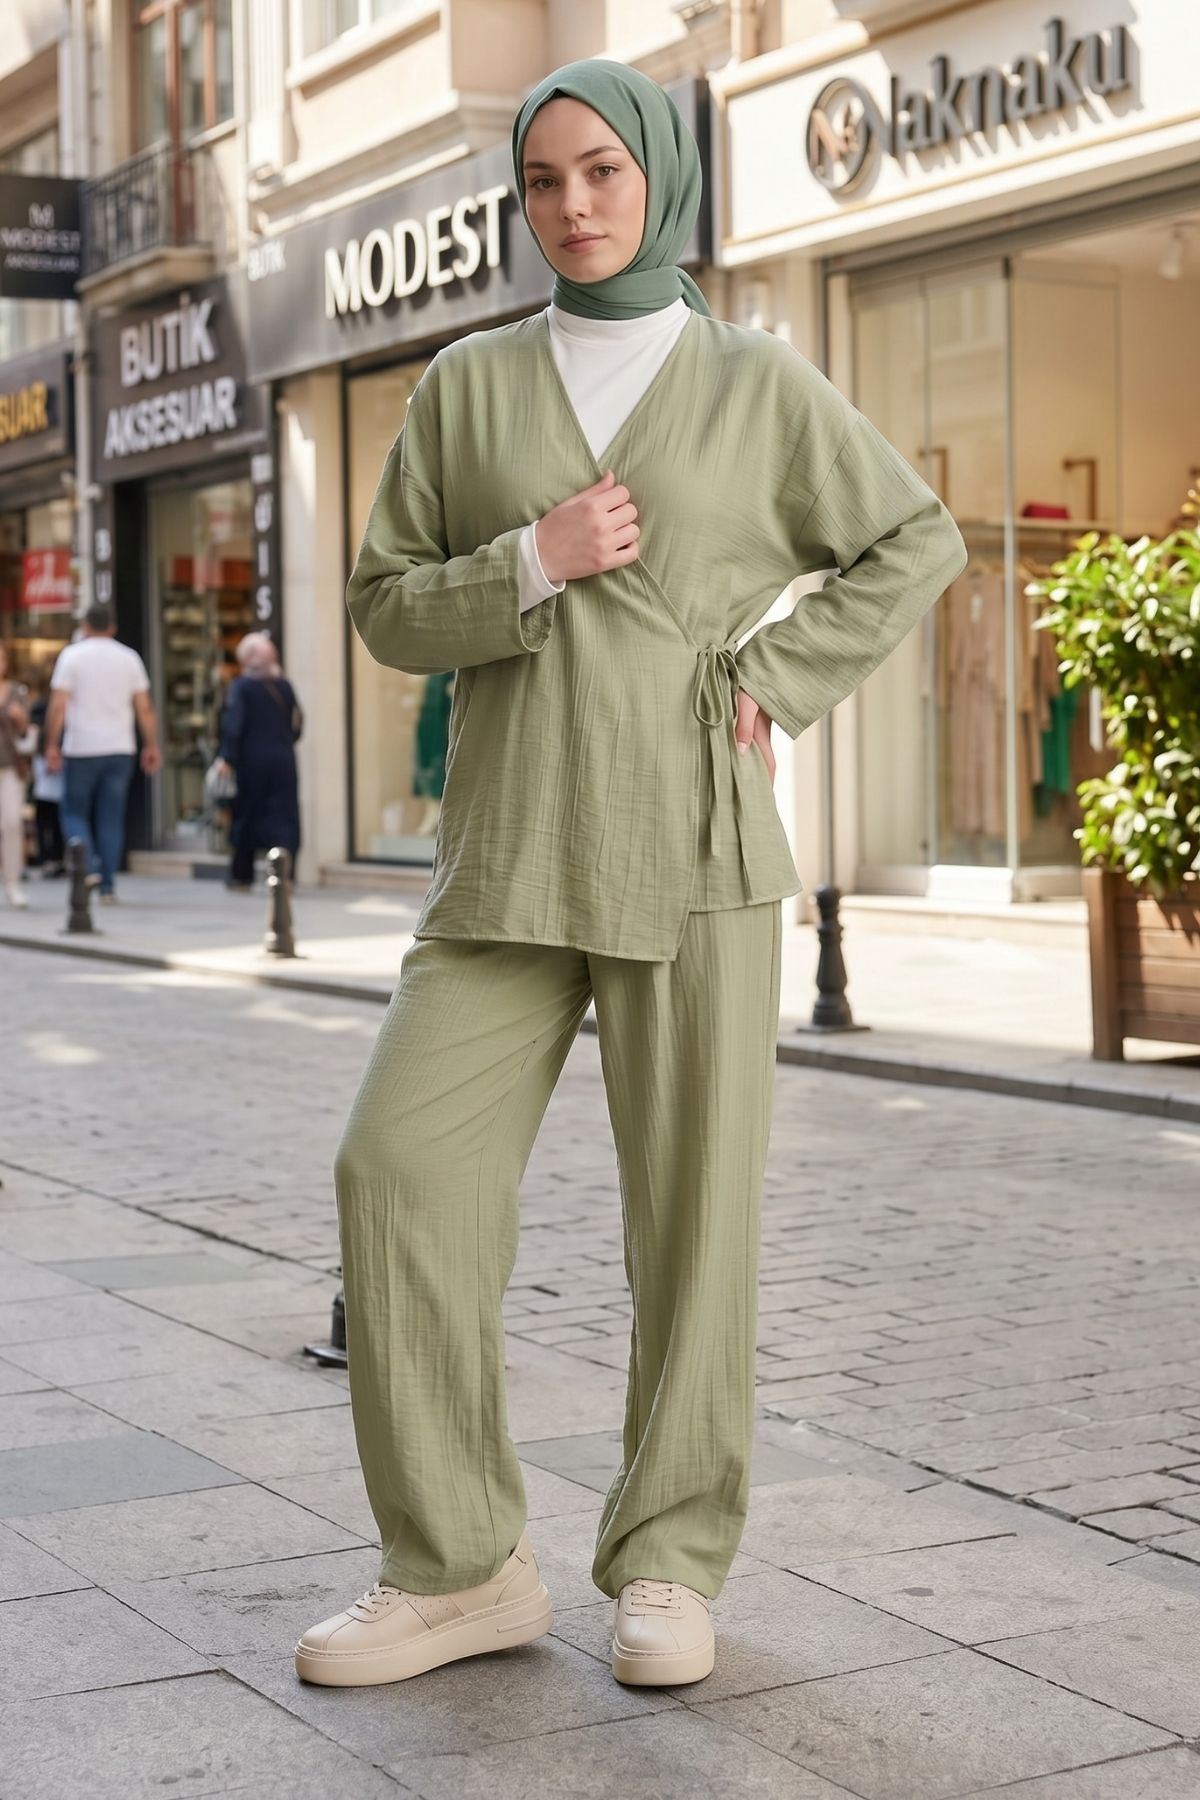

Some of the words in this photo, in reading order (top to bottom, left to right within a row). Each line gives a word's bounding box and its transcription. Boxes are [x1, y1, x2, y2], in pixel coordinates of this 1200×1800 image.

[29, 202, 55, 228] M
[325, 184, 508, 319] MODEST
[104, 376, 237, 459] AKSESUAR
